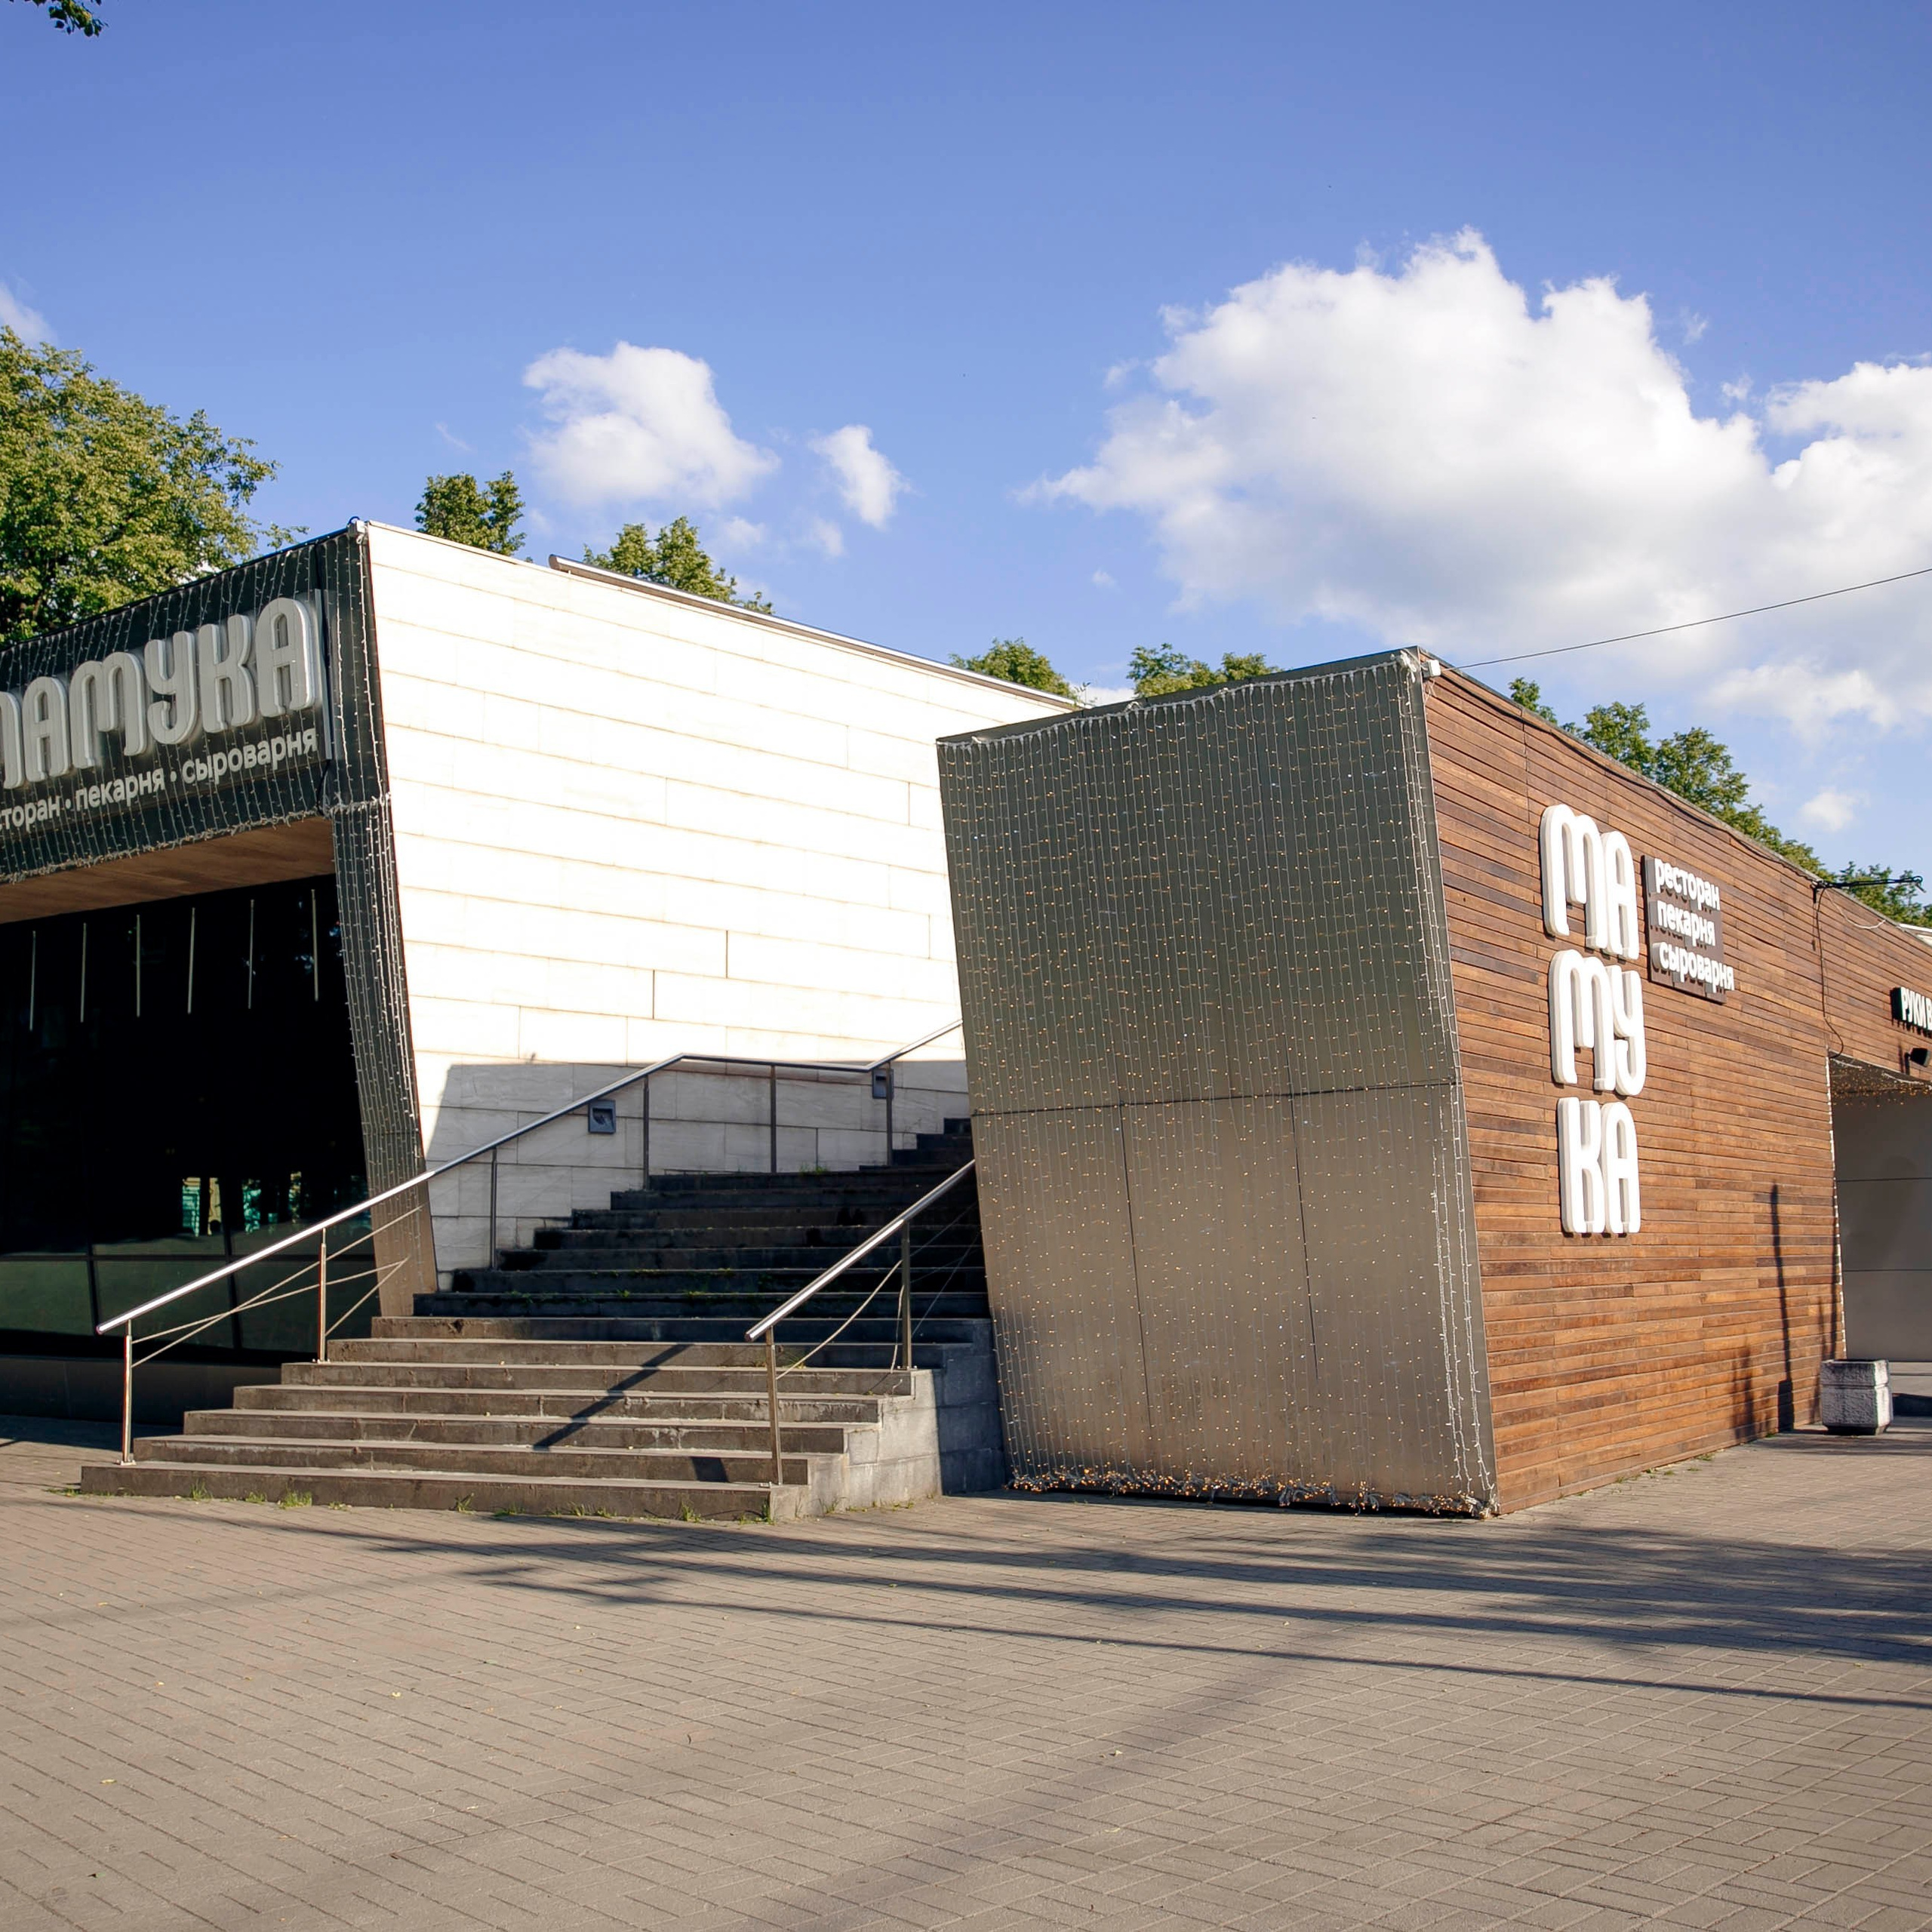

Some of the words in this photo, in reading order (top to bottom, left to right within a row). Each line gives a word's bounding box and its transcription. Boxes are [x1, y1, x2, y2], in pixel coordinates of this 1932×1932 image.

[0, 597, 315, 789] АМУКА
[0, 795, 61, 834] торан
[75, 768, 165, 808] пекарня
[182, 728, 317, 785] сыроварня
[1540, 804, 1639, 959] МА
[1654, 857, 1721, 911] ресторан
[1657, 900, 1716, 946] пекарня
[1549, 949, 1646, 1096] МУ
[1659, 941, 1735, 994] сыроварня
[1557, 1097, 1641, 1235] КА
